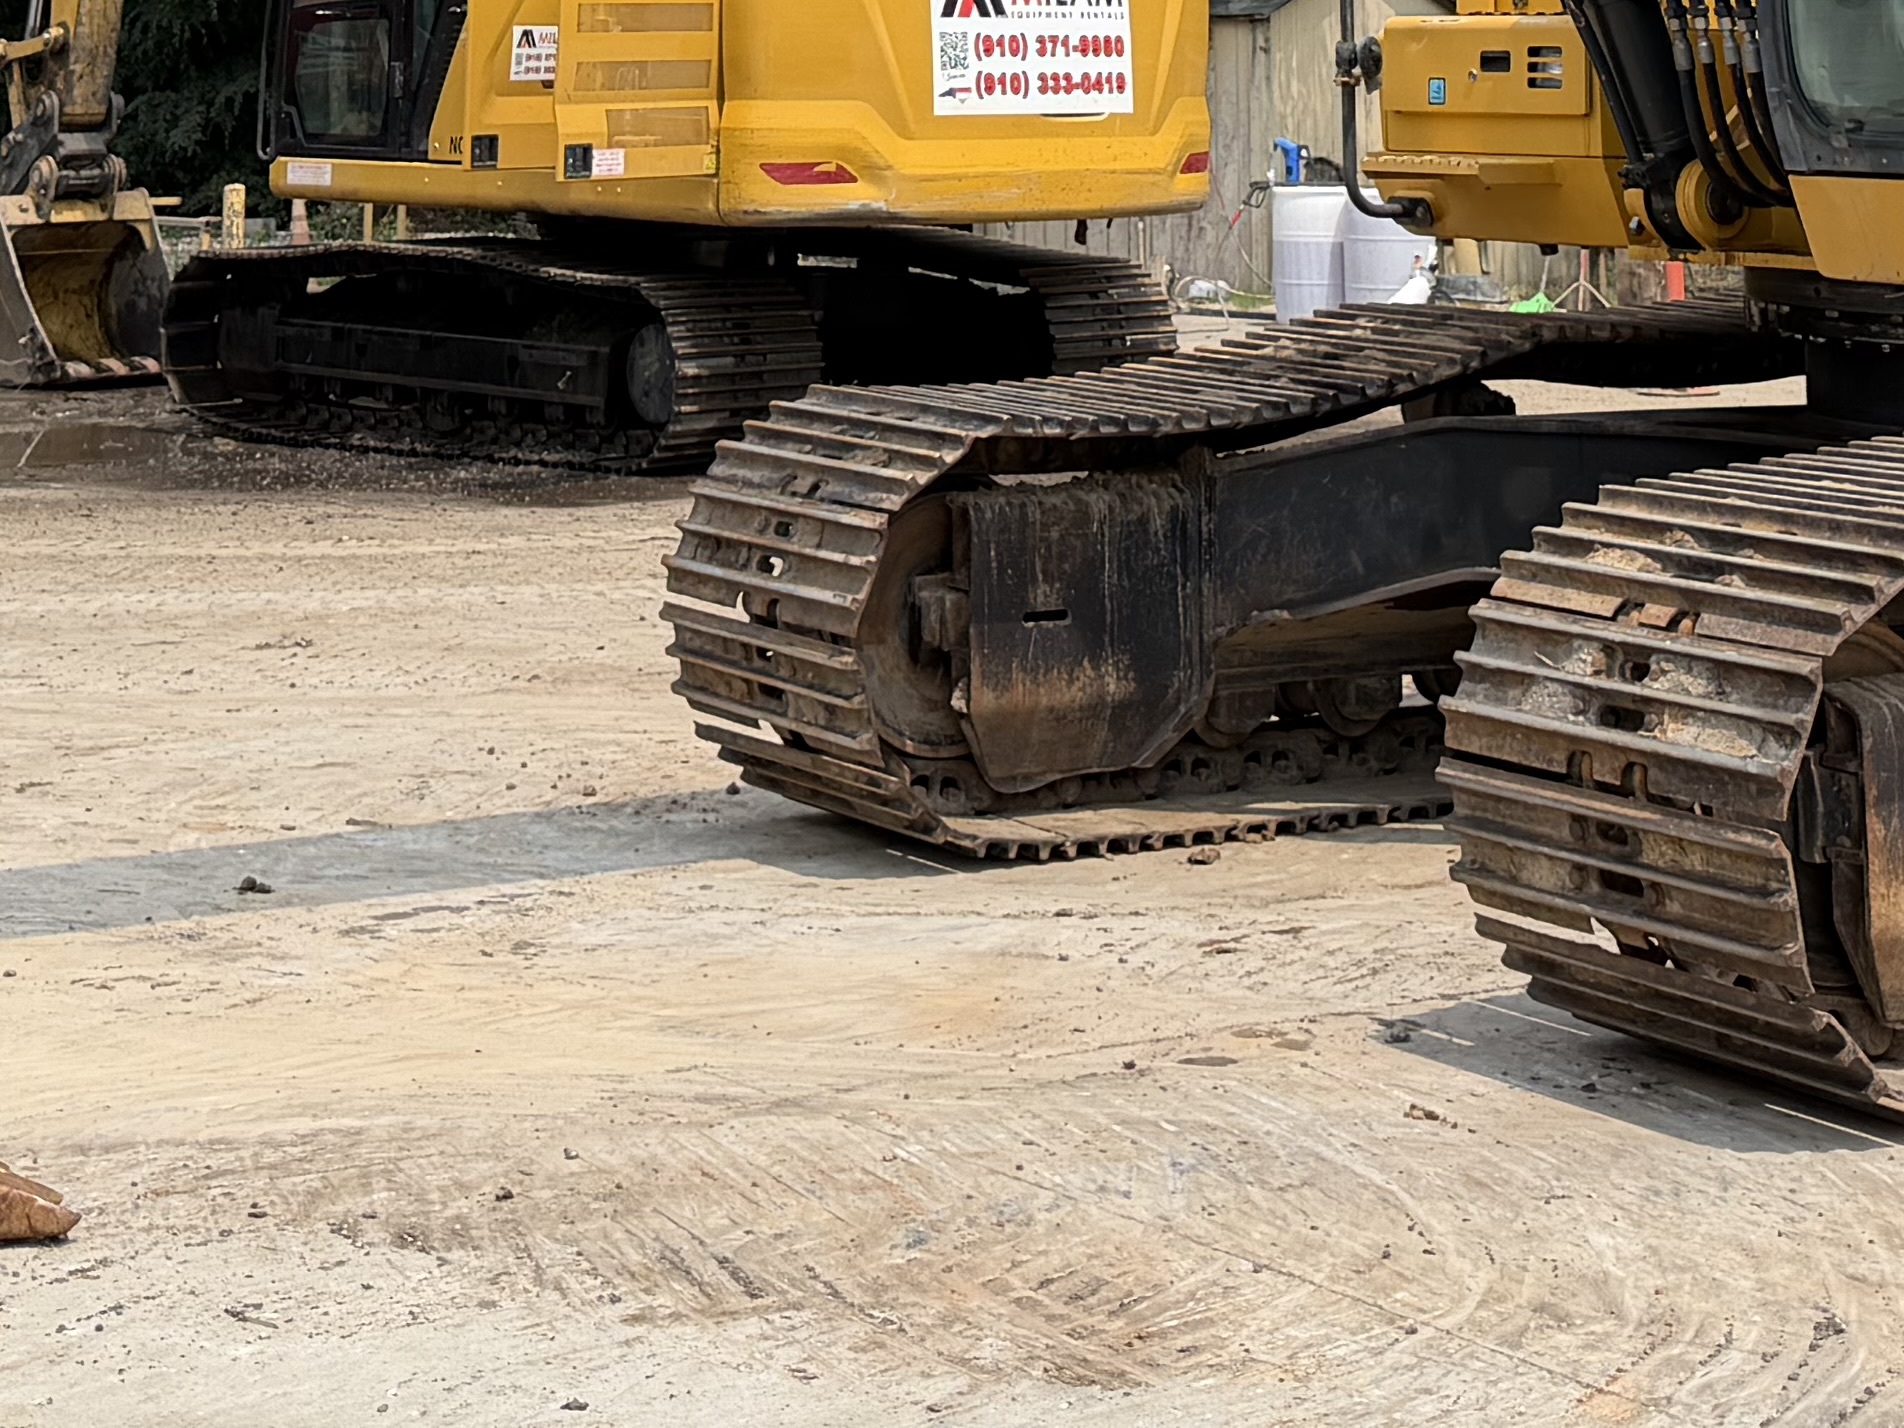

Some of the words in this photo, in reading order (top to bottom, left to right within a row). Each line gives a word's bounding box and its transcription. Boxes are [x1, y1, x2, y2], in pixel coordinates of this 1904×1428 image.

[1011, 10, 1073, 20] EQUIPMENT
[1080, 11, 1125, 20] RENTALS
[974, 32, 1028, 61] (910)
[975, 70, 1030, 99] (910)
